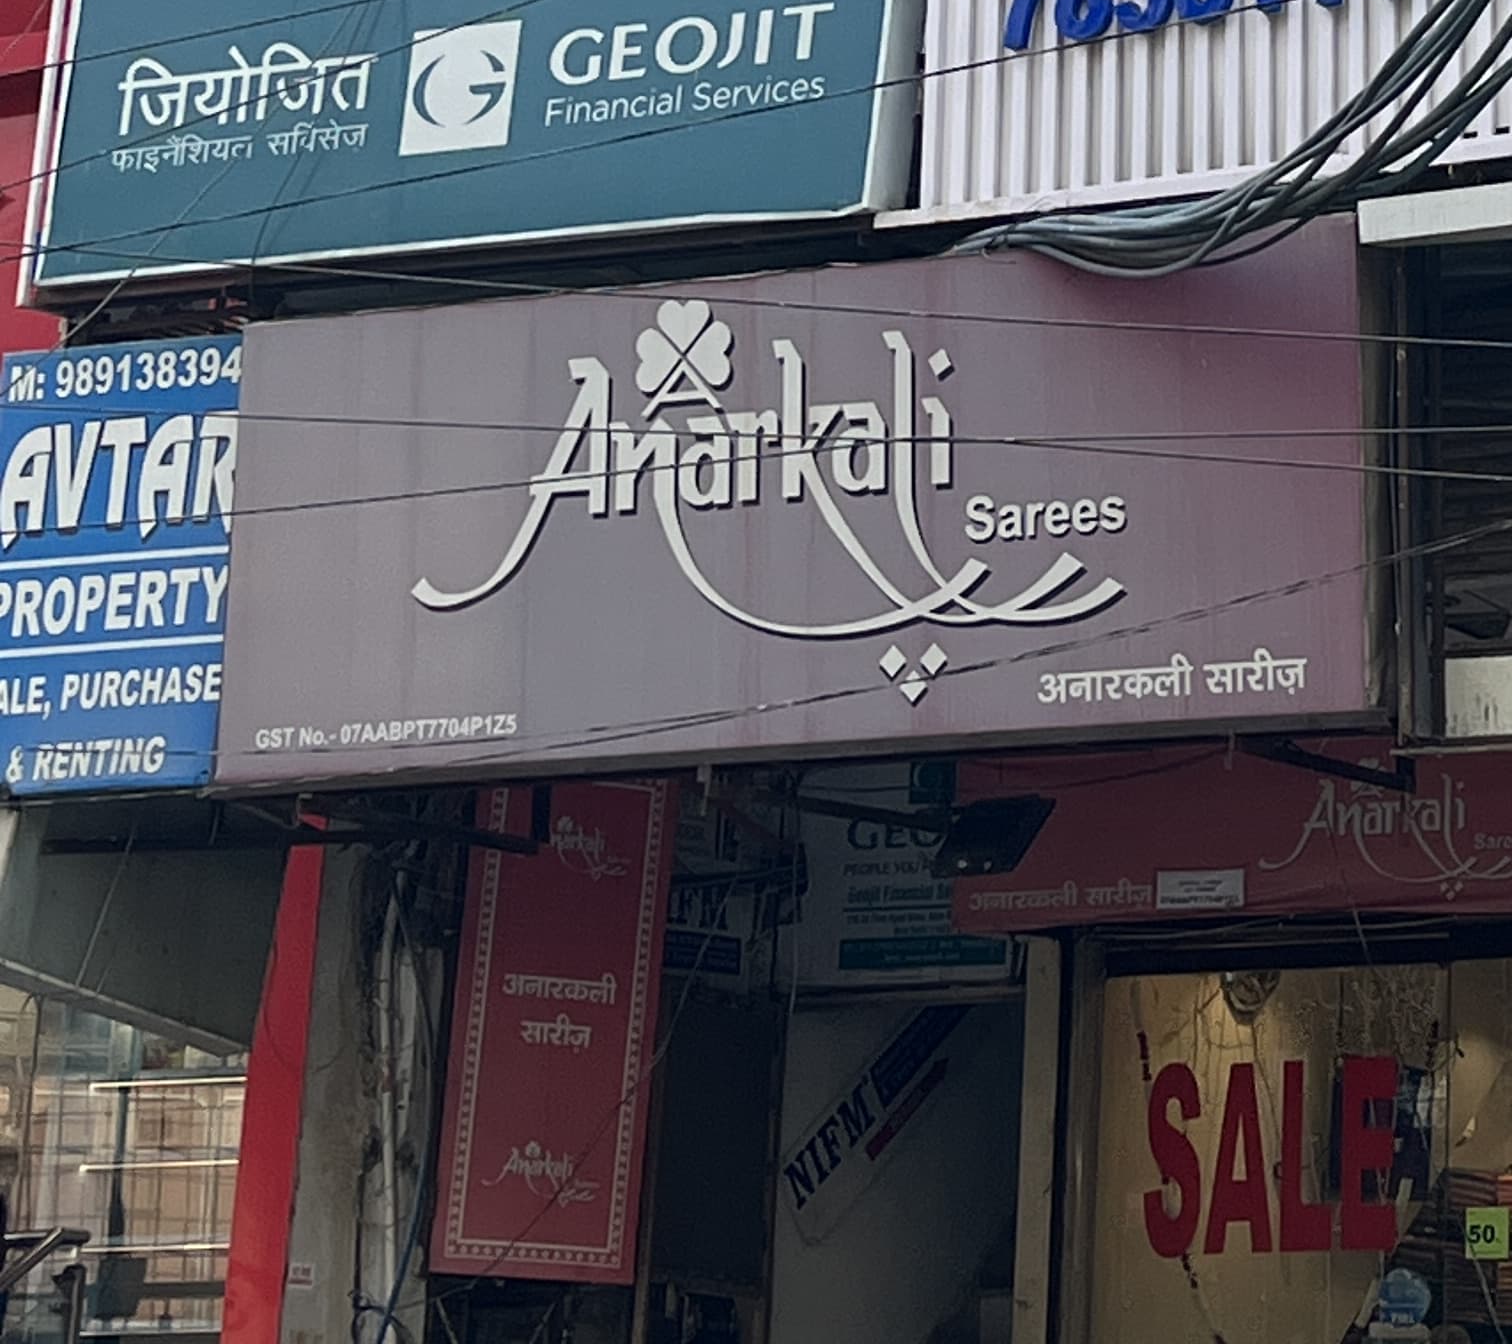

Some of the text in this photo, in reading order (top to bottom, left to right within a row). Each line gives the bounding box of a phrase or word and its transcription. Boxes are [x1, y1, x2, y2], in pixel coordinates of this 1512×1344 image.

[547, 0, 835, 87] GEOJIT
[118, 42, 379, 136] जियोजित
[546, 72, 826, 127] Financial Services
[0, 411, 239, 550] AVTAR
[964, 490, 1128, 543] Sarees
[60, 663, 223, 711] PURCHASE
[1037, 653, 1193, 705] अनारकली
[33, 736, 168, 782] RENTING
[255, 726, 296, 749] GST
[502, 972, 617, 1005] अनारकली
[784, 1082, 875, 1209] NIFM
[1142, 1055, 1397, 1260] SALE
